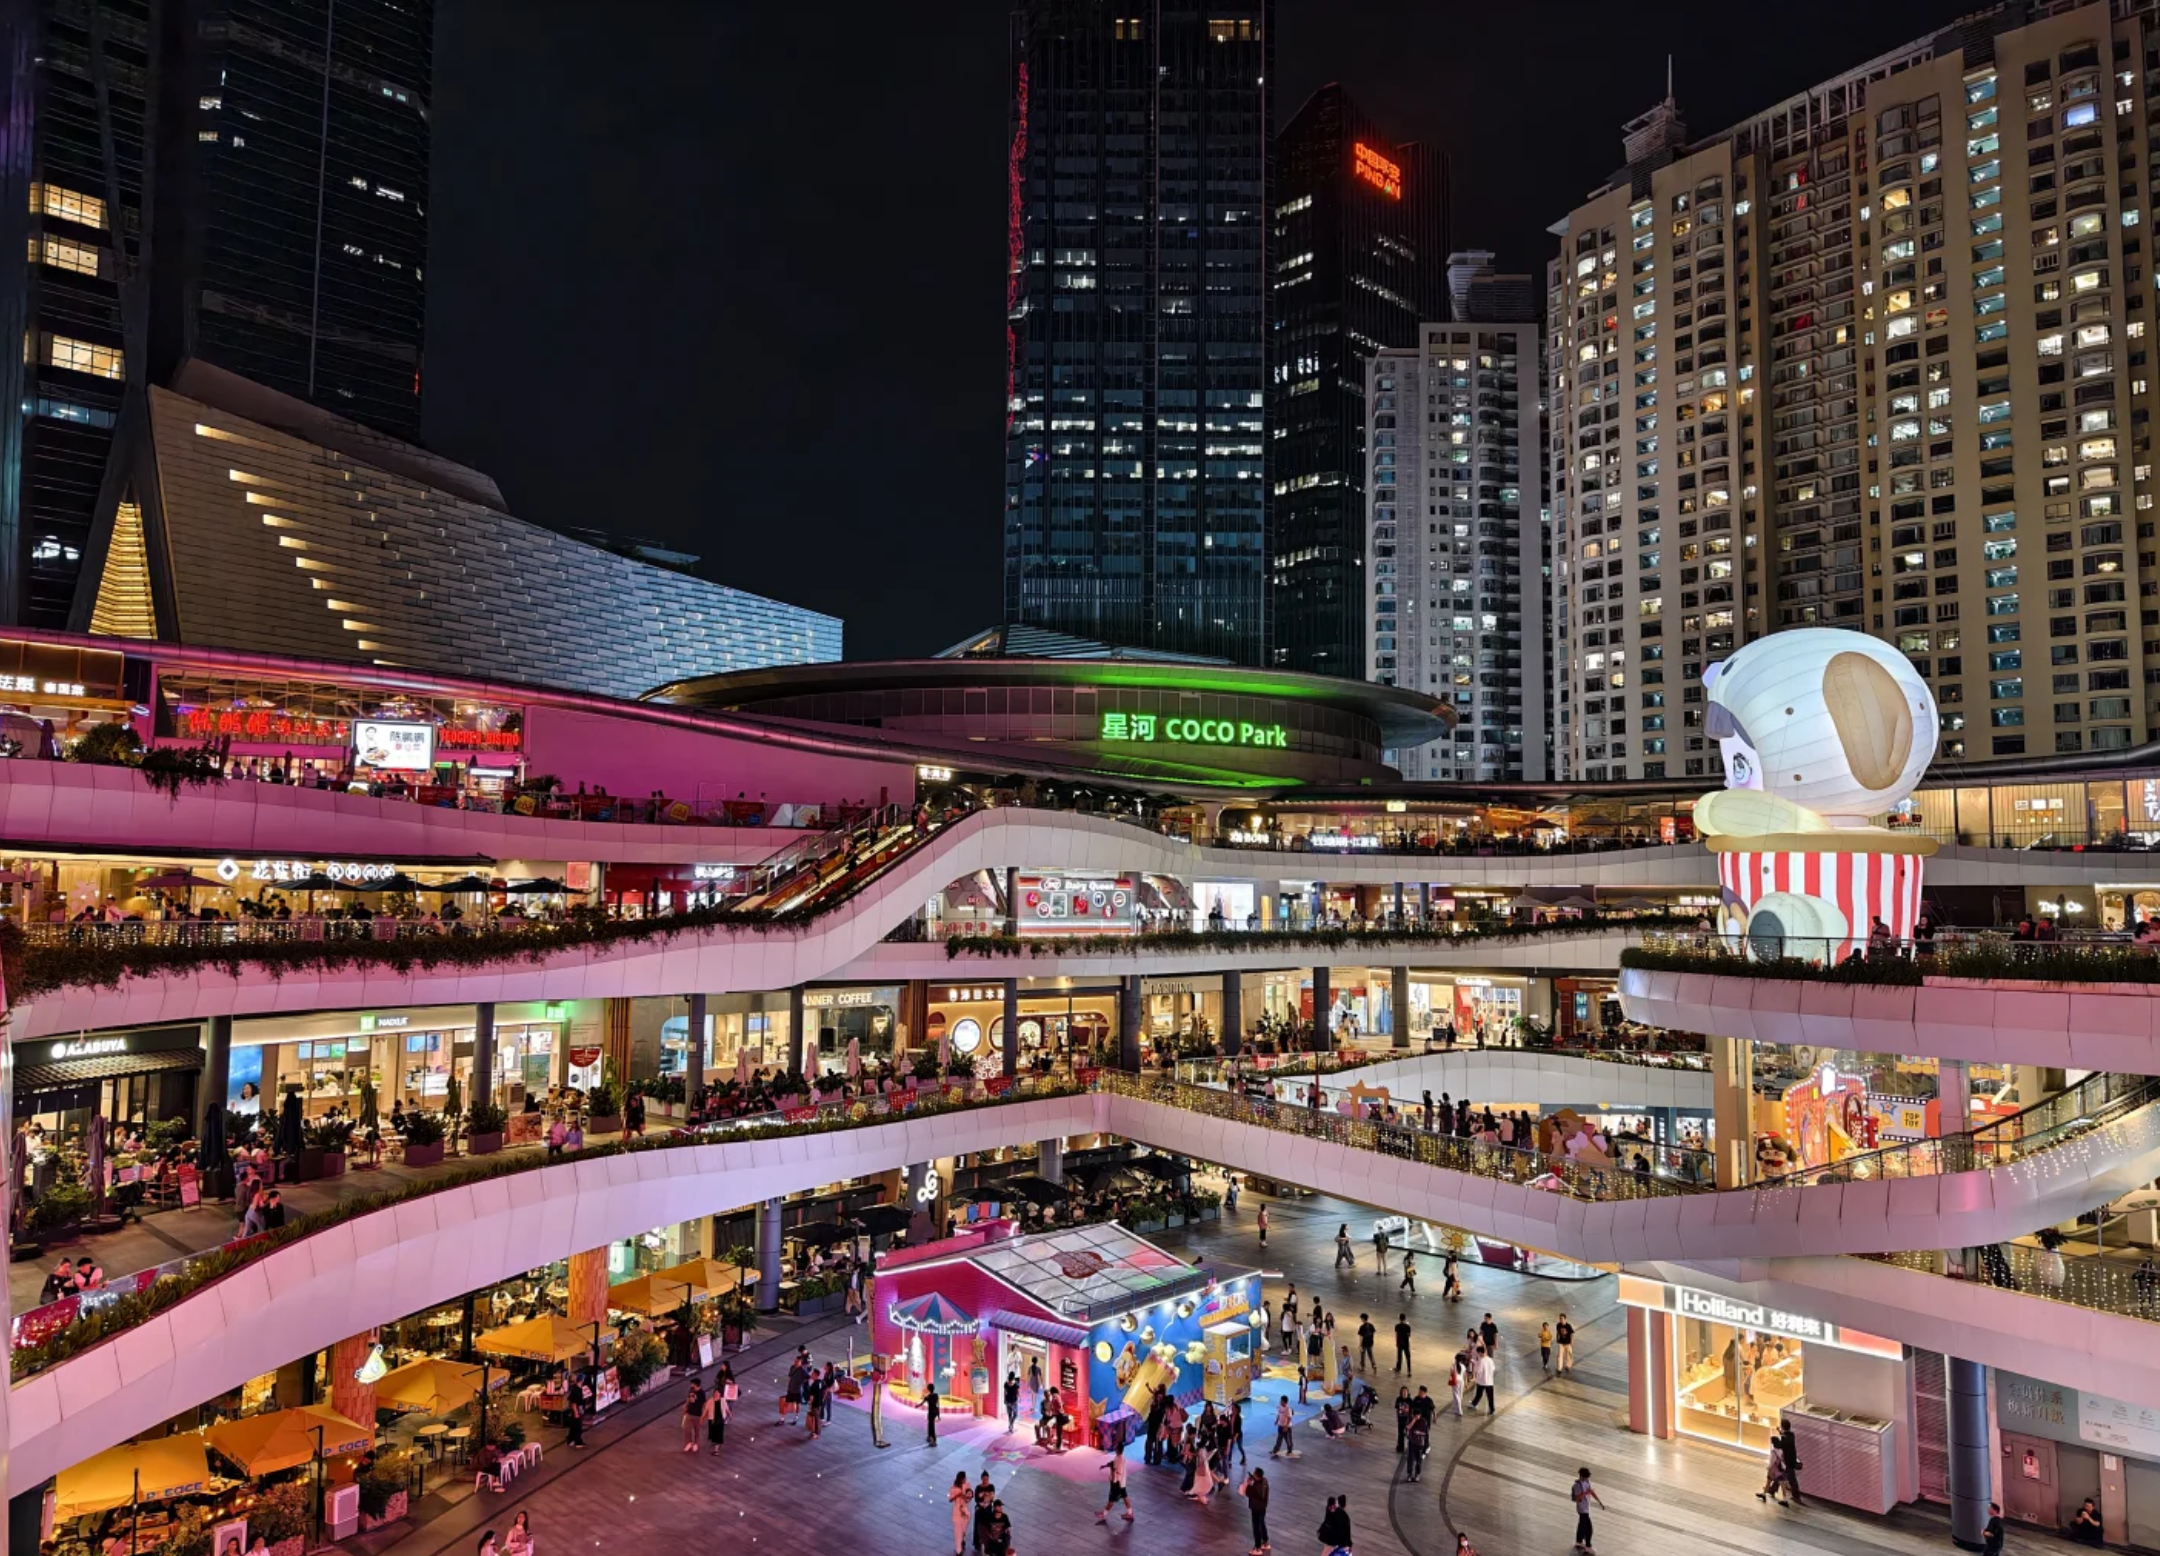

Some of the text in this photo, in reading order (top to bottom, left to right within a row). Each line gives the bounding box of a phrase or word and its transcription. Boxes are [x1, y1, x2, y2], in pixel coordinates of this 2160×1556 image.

[1355, 143, 1401, 182] 中国平安
[1102, 713, 1287, 747] 星河 COCO Park
[486, 731, 520, 747] BISTRO
[1065, 881, 1087, 892] Dairy
[1089, 881, 1115, 892] Queen
[802, 992, 873, 1006] ANNER COFFEE
[66, 1037, 126, 1056] AZABUYA
[1904, 1119, 1919, 1128] TOY
[1905, 1112, 1920, 1120] TOP
[1770, 1311, 1821, 1336] 好利来
